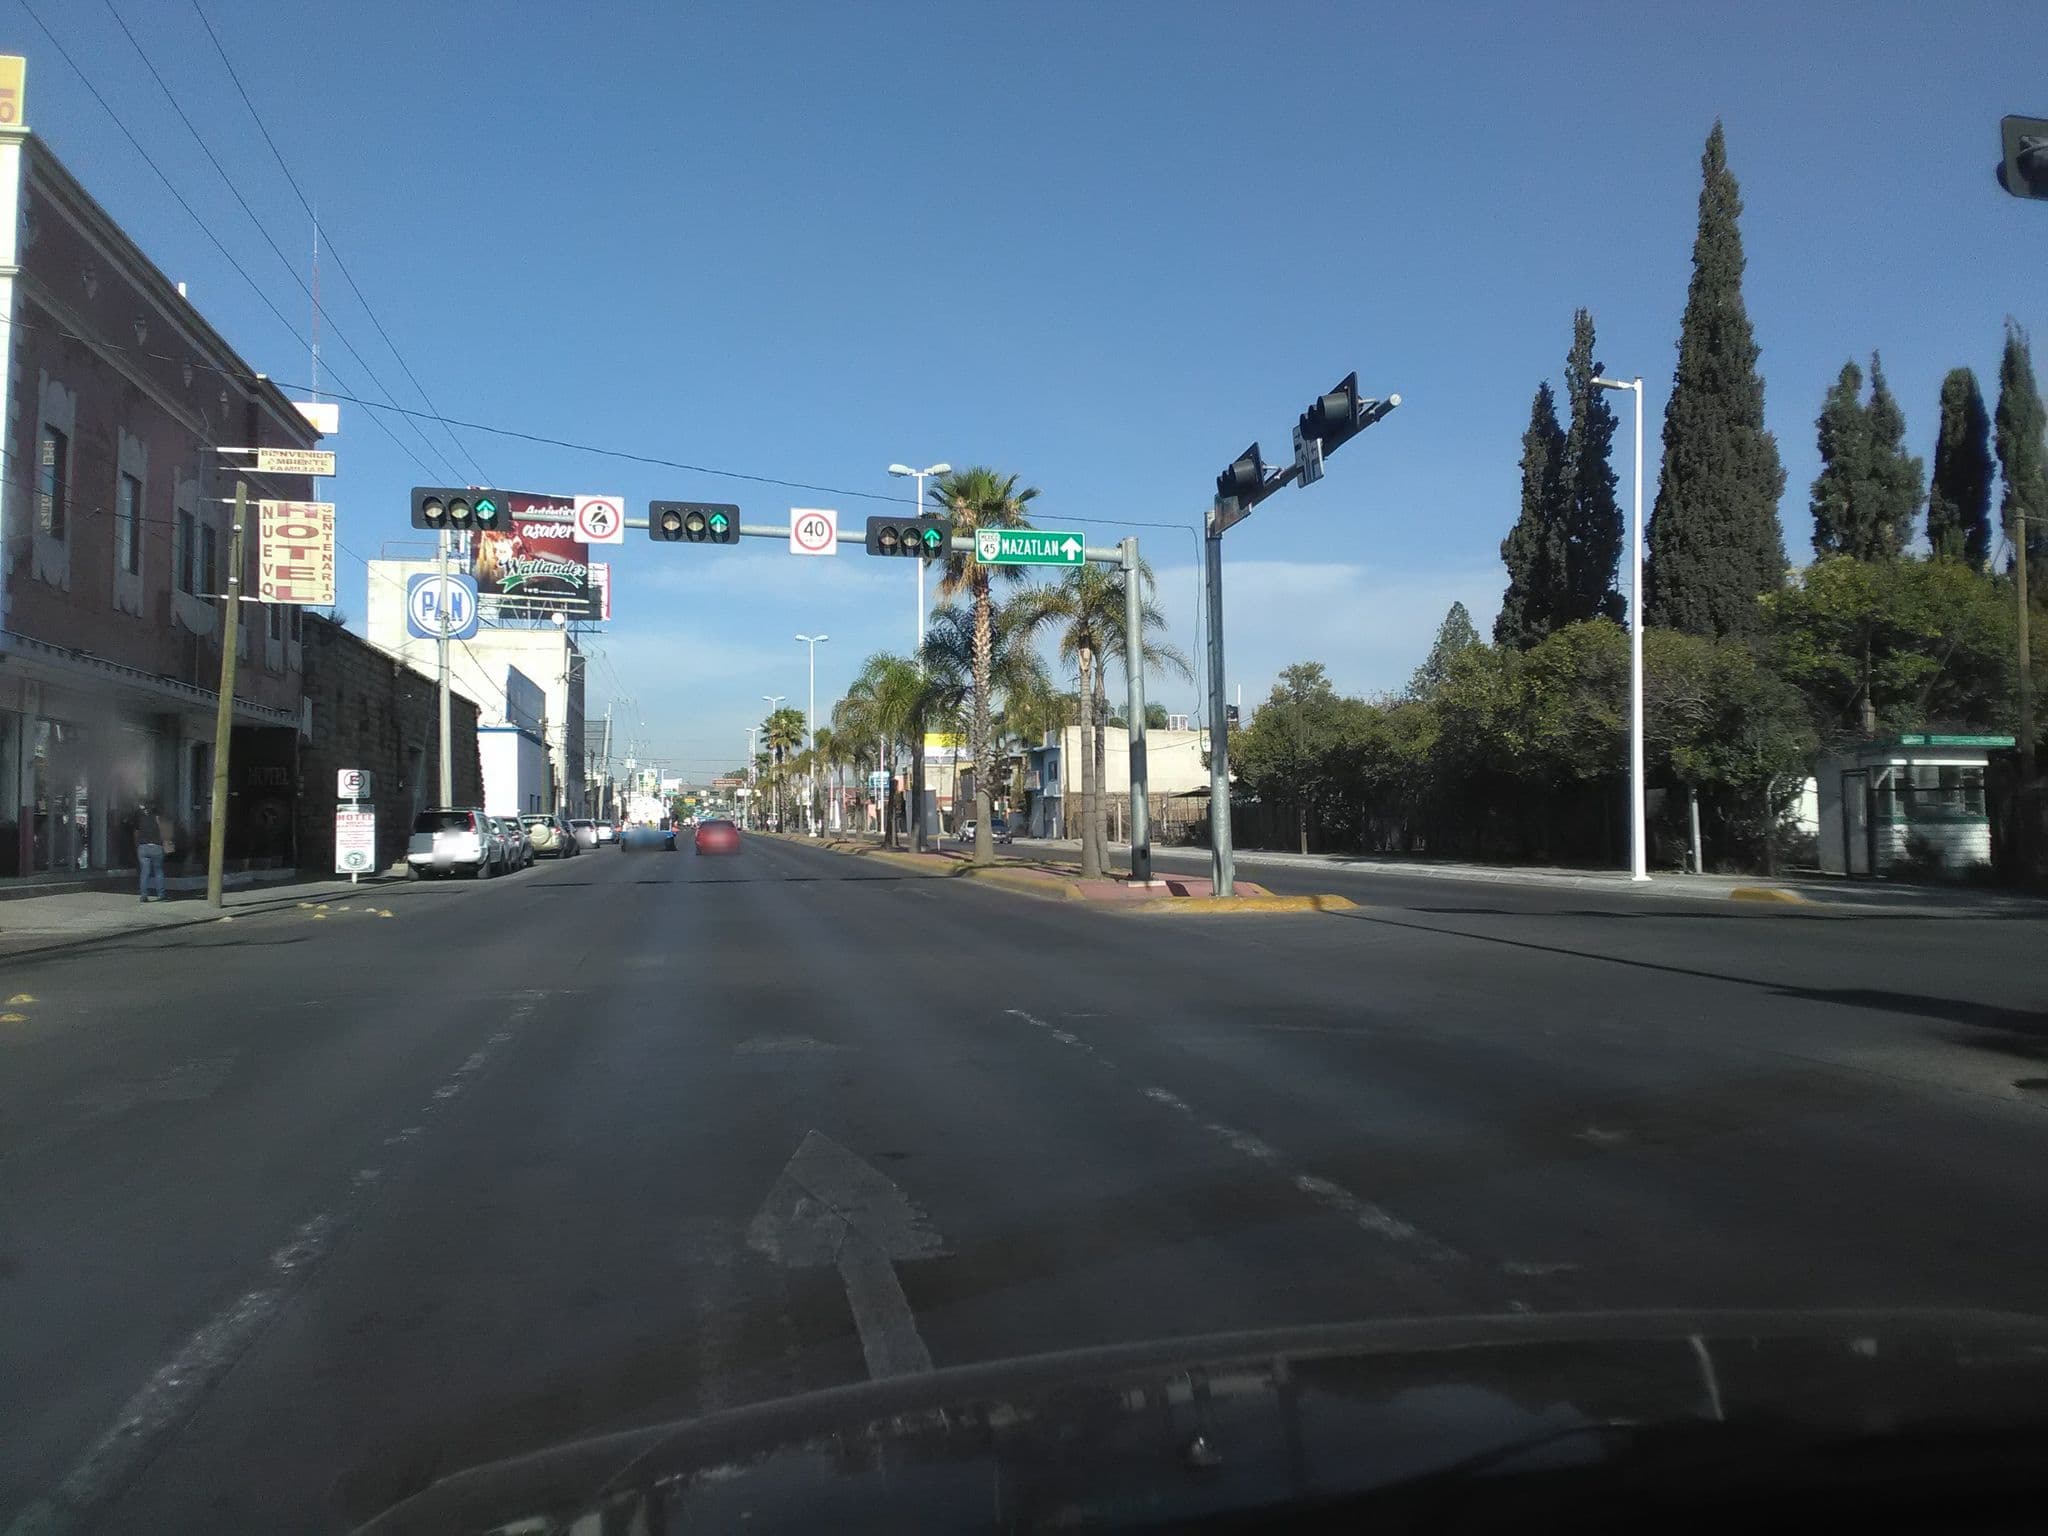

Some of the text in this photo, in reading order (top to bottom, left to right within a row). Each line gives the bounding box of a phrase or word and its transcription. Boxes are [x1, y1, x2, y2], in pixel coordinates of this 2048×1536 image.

[261, 449, 333, 459] BIENVENIDO
[522, 522, 575, 539] asader
[803, 520, 825, 537] 40
[262, 505, 274, 597] NUEVO
[275, 502, 320, 601] HOTEL
[322, 504, 333, 601] CENTENARIO
[983, 543, 996, 554] 45
[1001, 538, 1059, 556] MAZATLAN
[502, 555, 587, 578] Wallander
[336, 813, 373, 821] HOTEL
